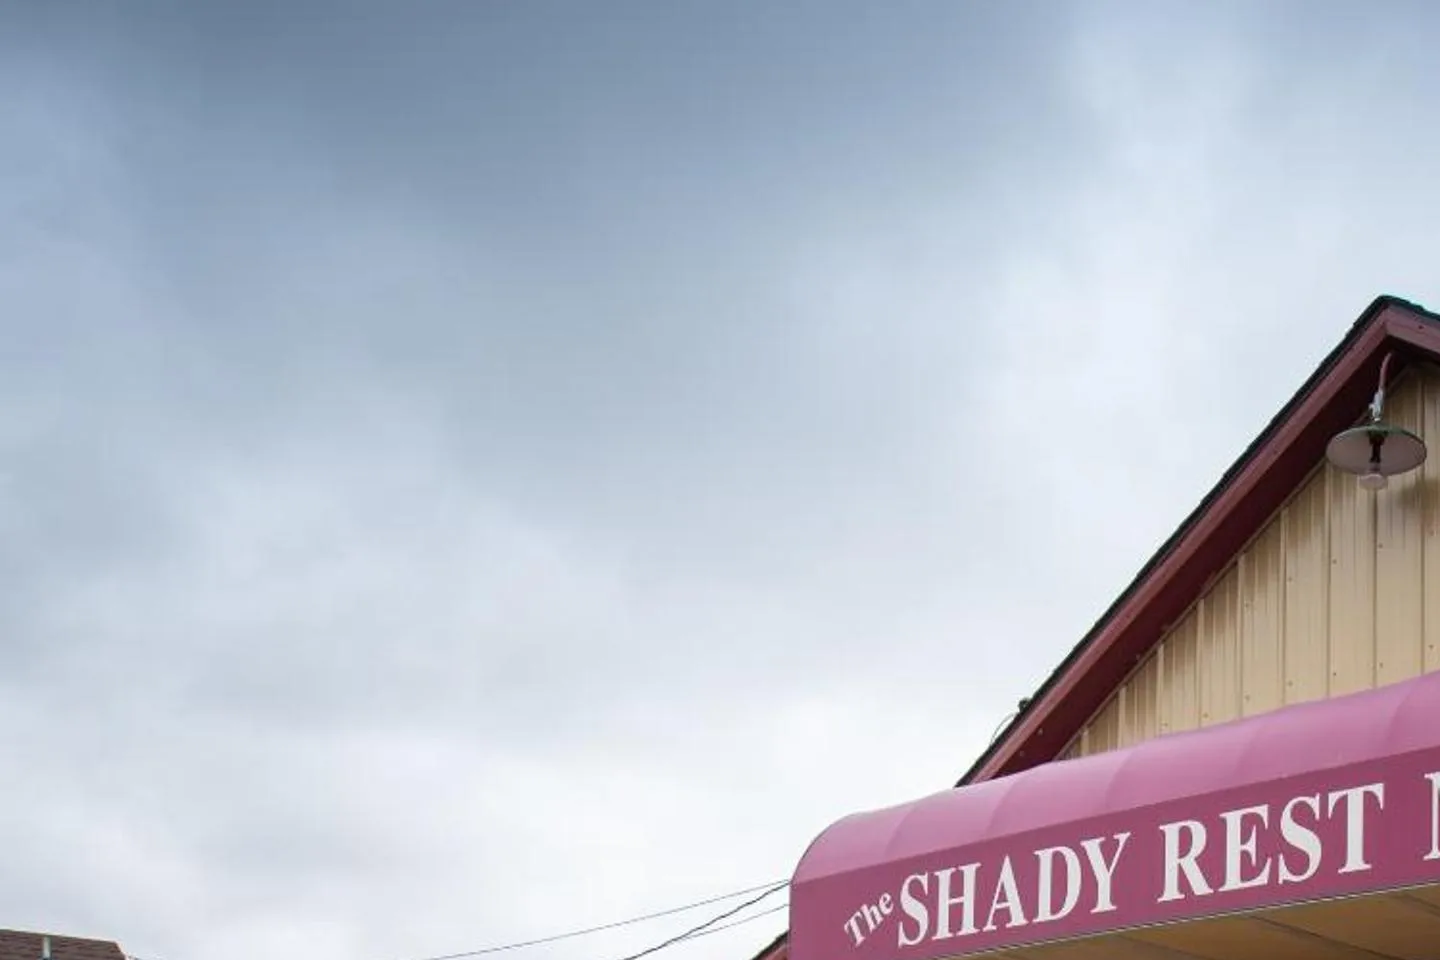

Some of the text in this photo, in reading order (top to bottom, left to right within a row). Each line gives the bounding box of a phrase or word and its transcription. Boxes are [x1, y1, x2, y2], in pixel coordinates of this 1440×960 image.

[843, 892, 894, 946] The
[898, 832, 1131, 949] SHADY
[1157, 783, 1385, 903] REST
